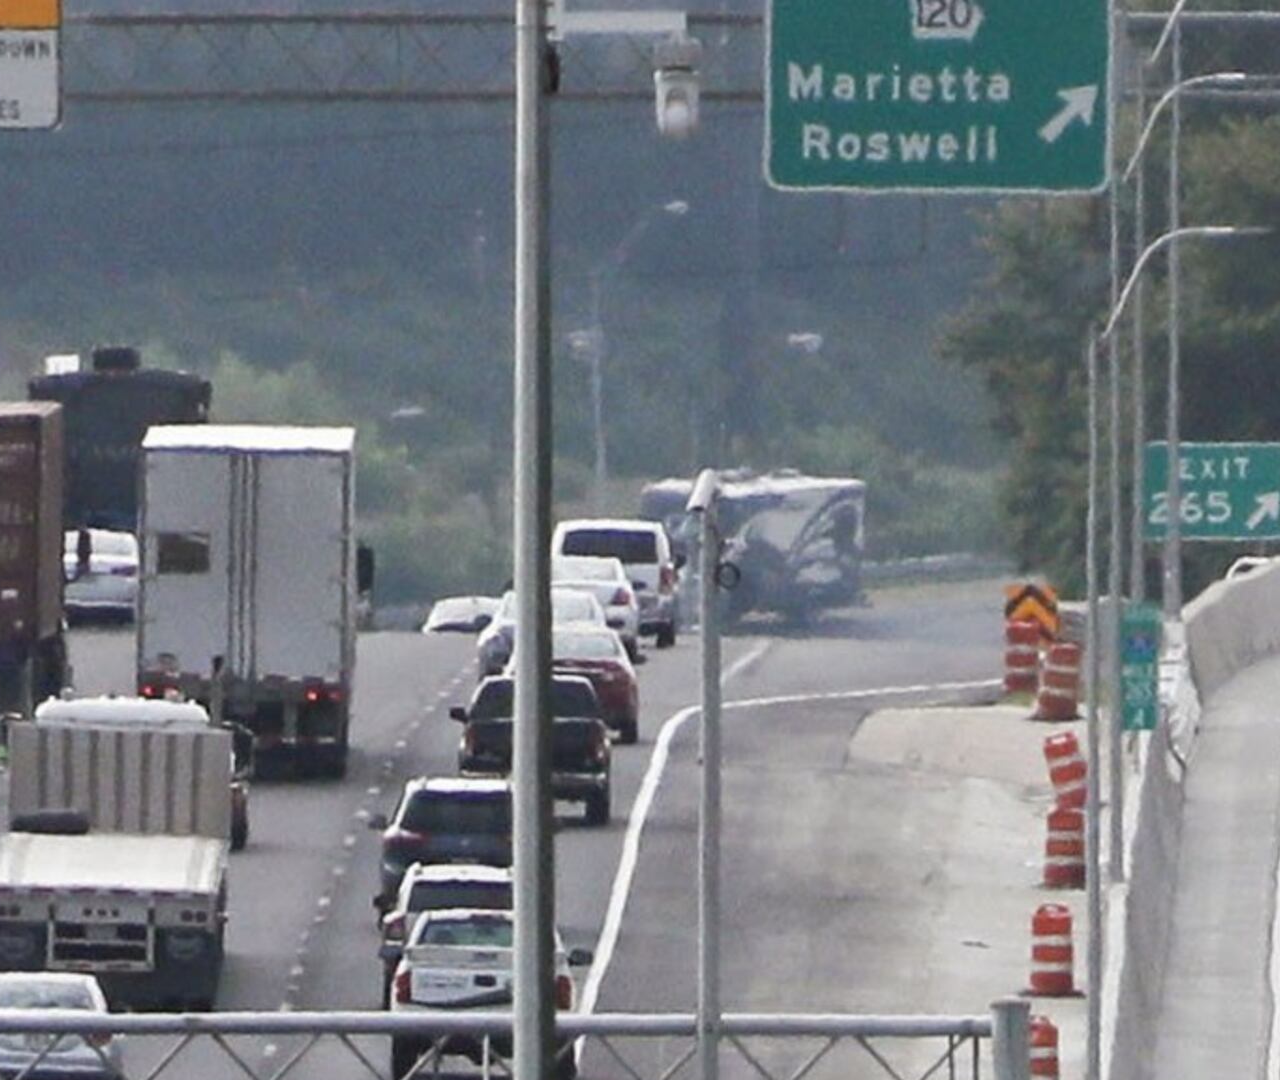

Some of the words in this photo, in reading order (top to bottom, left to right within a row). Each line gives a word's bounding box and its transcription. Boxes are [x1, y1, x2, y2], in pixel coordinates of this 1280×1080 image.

[917, 0, 973, 28] 120
[787, 62, 1010, 101] Marietta
[802, 123, 998, 162] Roswell
[1179, 457, 1251, 480] EXIT
[1148, 489, 1233, 525] 265
